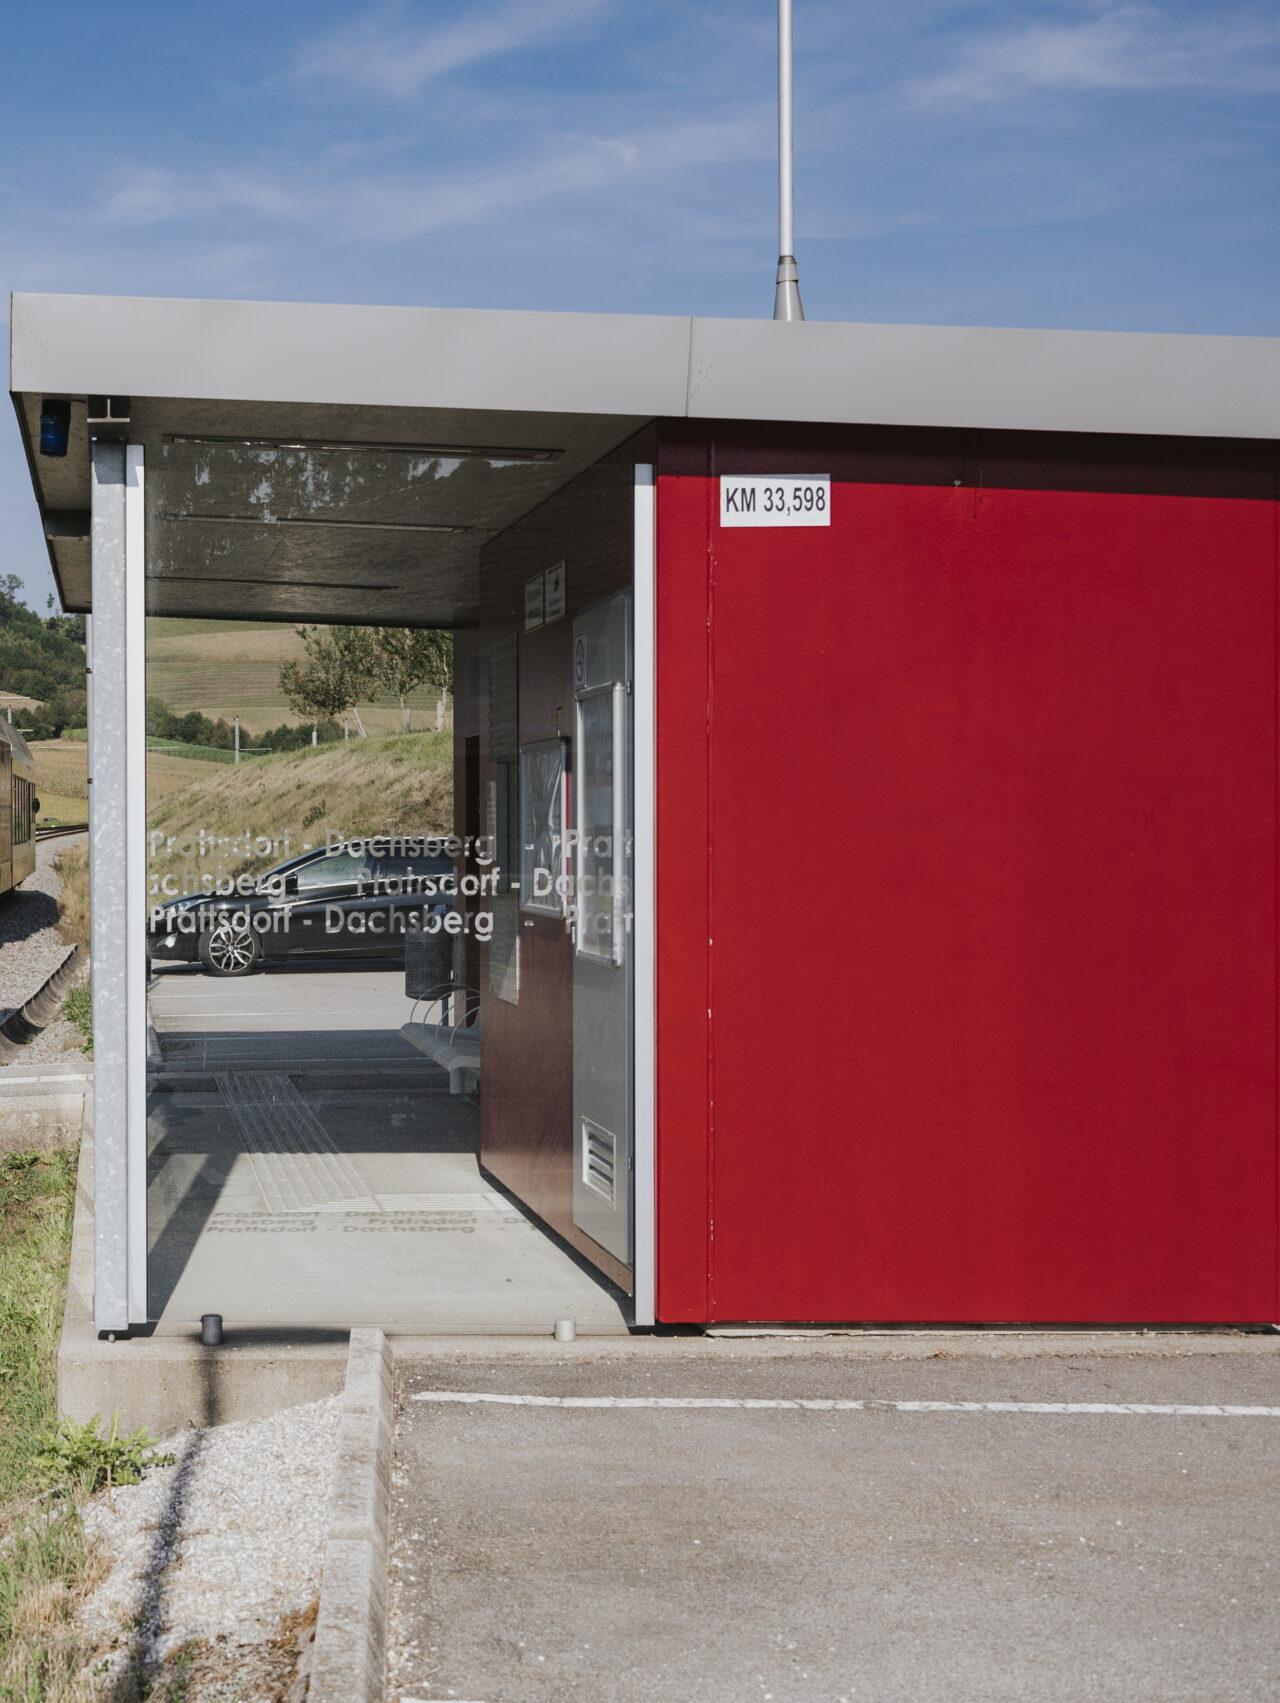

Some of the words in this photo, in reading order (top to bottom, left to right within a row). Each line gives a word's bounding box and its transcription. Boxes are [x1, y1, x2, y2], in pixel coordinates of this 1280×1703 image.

[726, 487, 756, 512] KM
[763, 486, 826, 517] 33,598
[325, 829, 497, 866] Dachsberg
[150, 904, 293, 934] Prattsdorf
[325, 904, 494, 942] Dachsberg
[343, 1225, 475, 1234] Dachsberg
